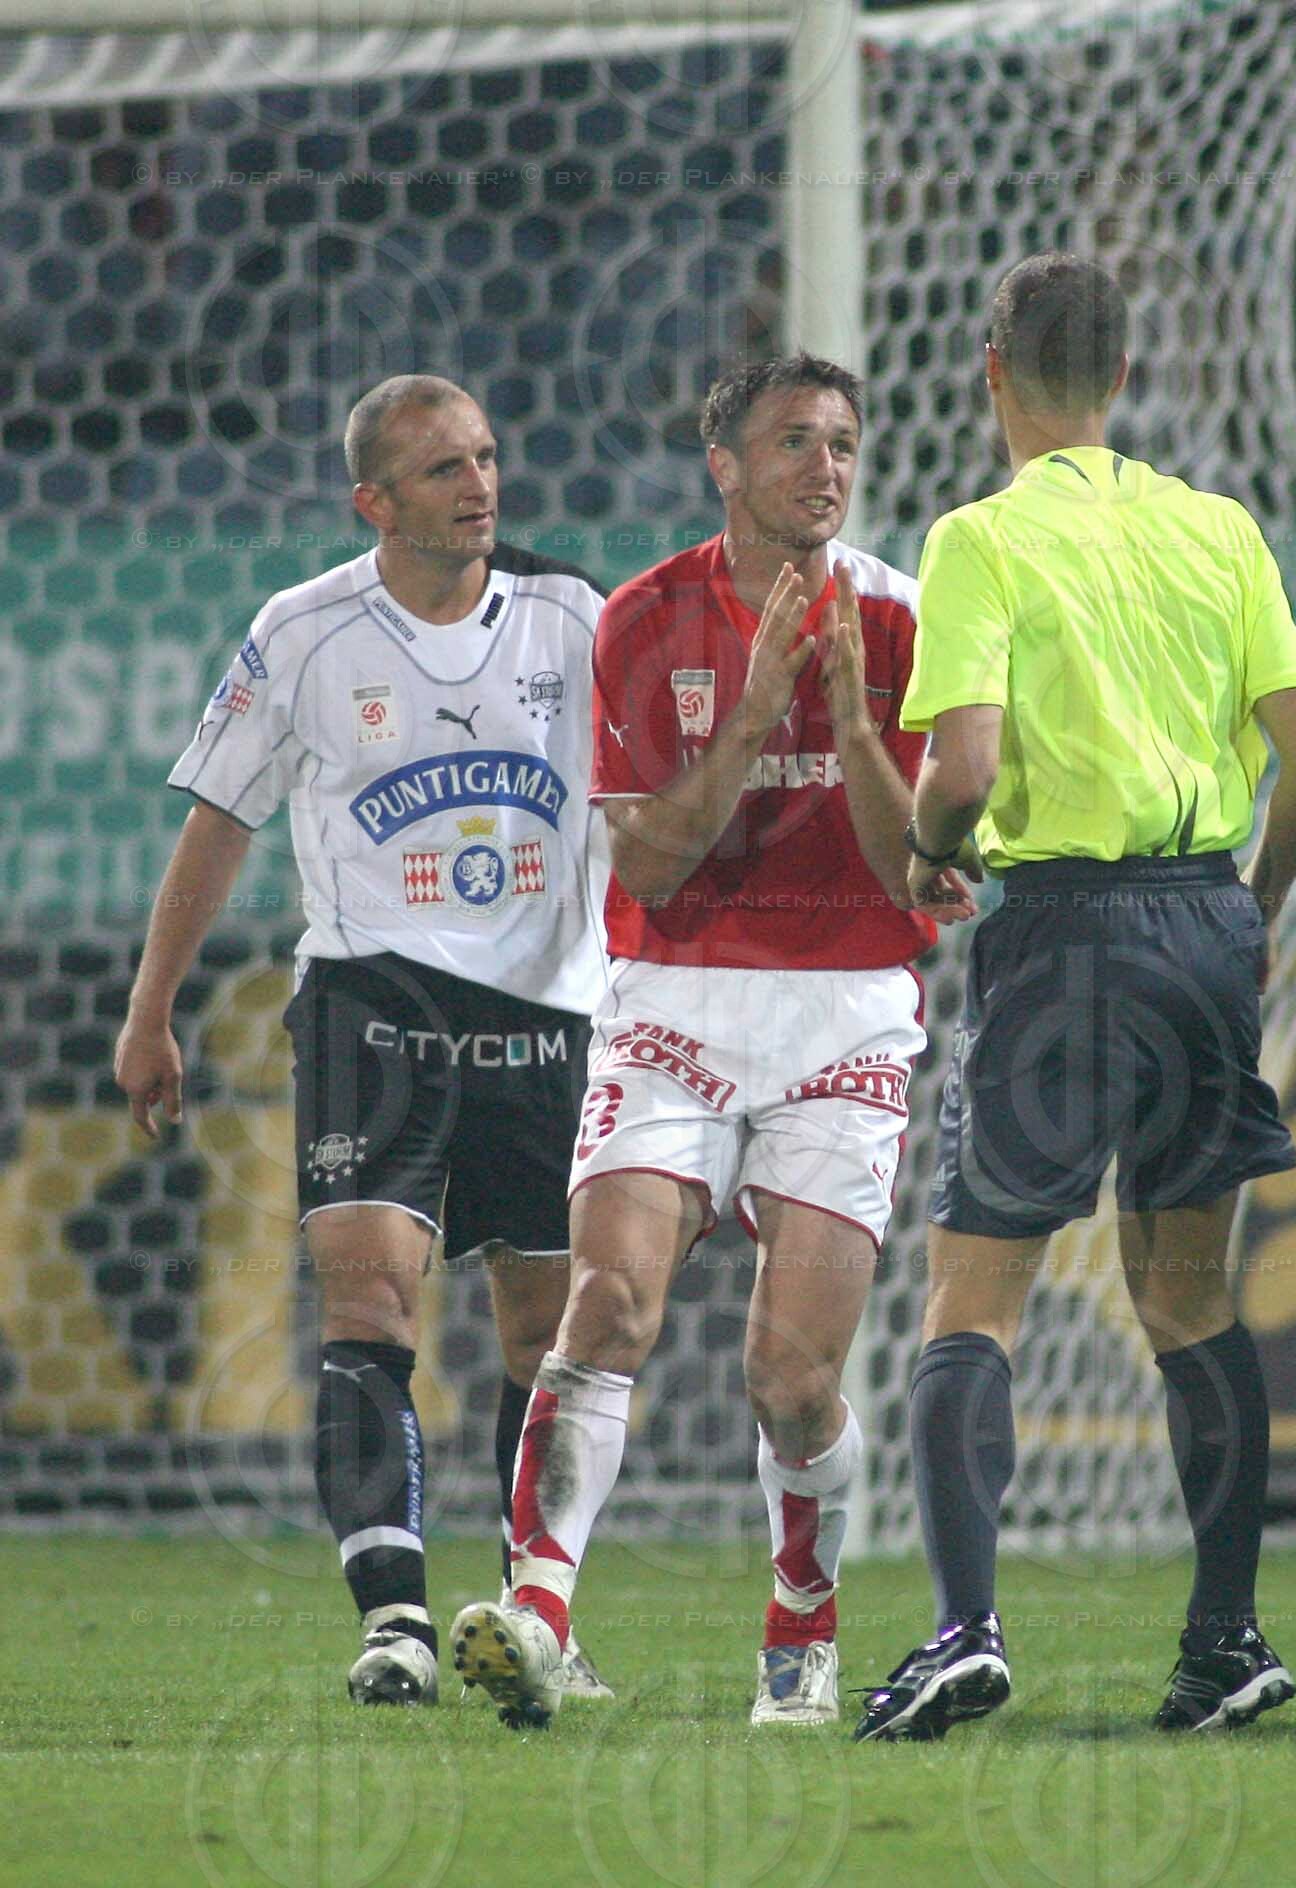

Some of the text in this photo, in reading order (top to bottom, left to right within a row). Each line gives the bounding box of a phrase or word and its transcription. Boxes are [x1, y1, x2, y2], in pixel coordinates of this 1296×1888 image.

[358, 760, 561, 834] PUNTIGAMER
[364, 1020, 568, 1067] CITYCOM
[800, 1071, 904, 1107] ROTH
